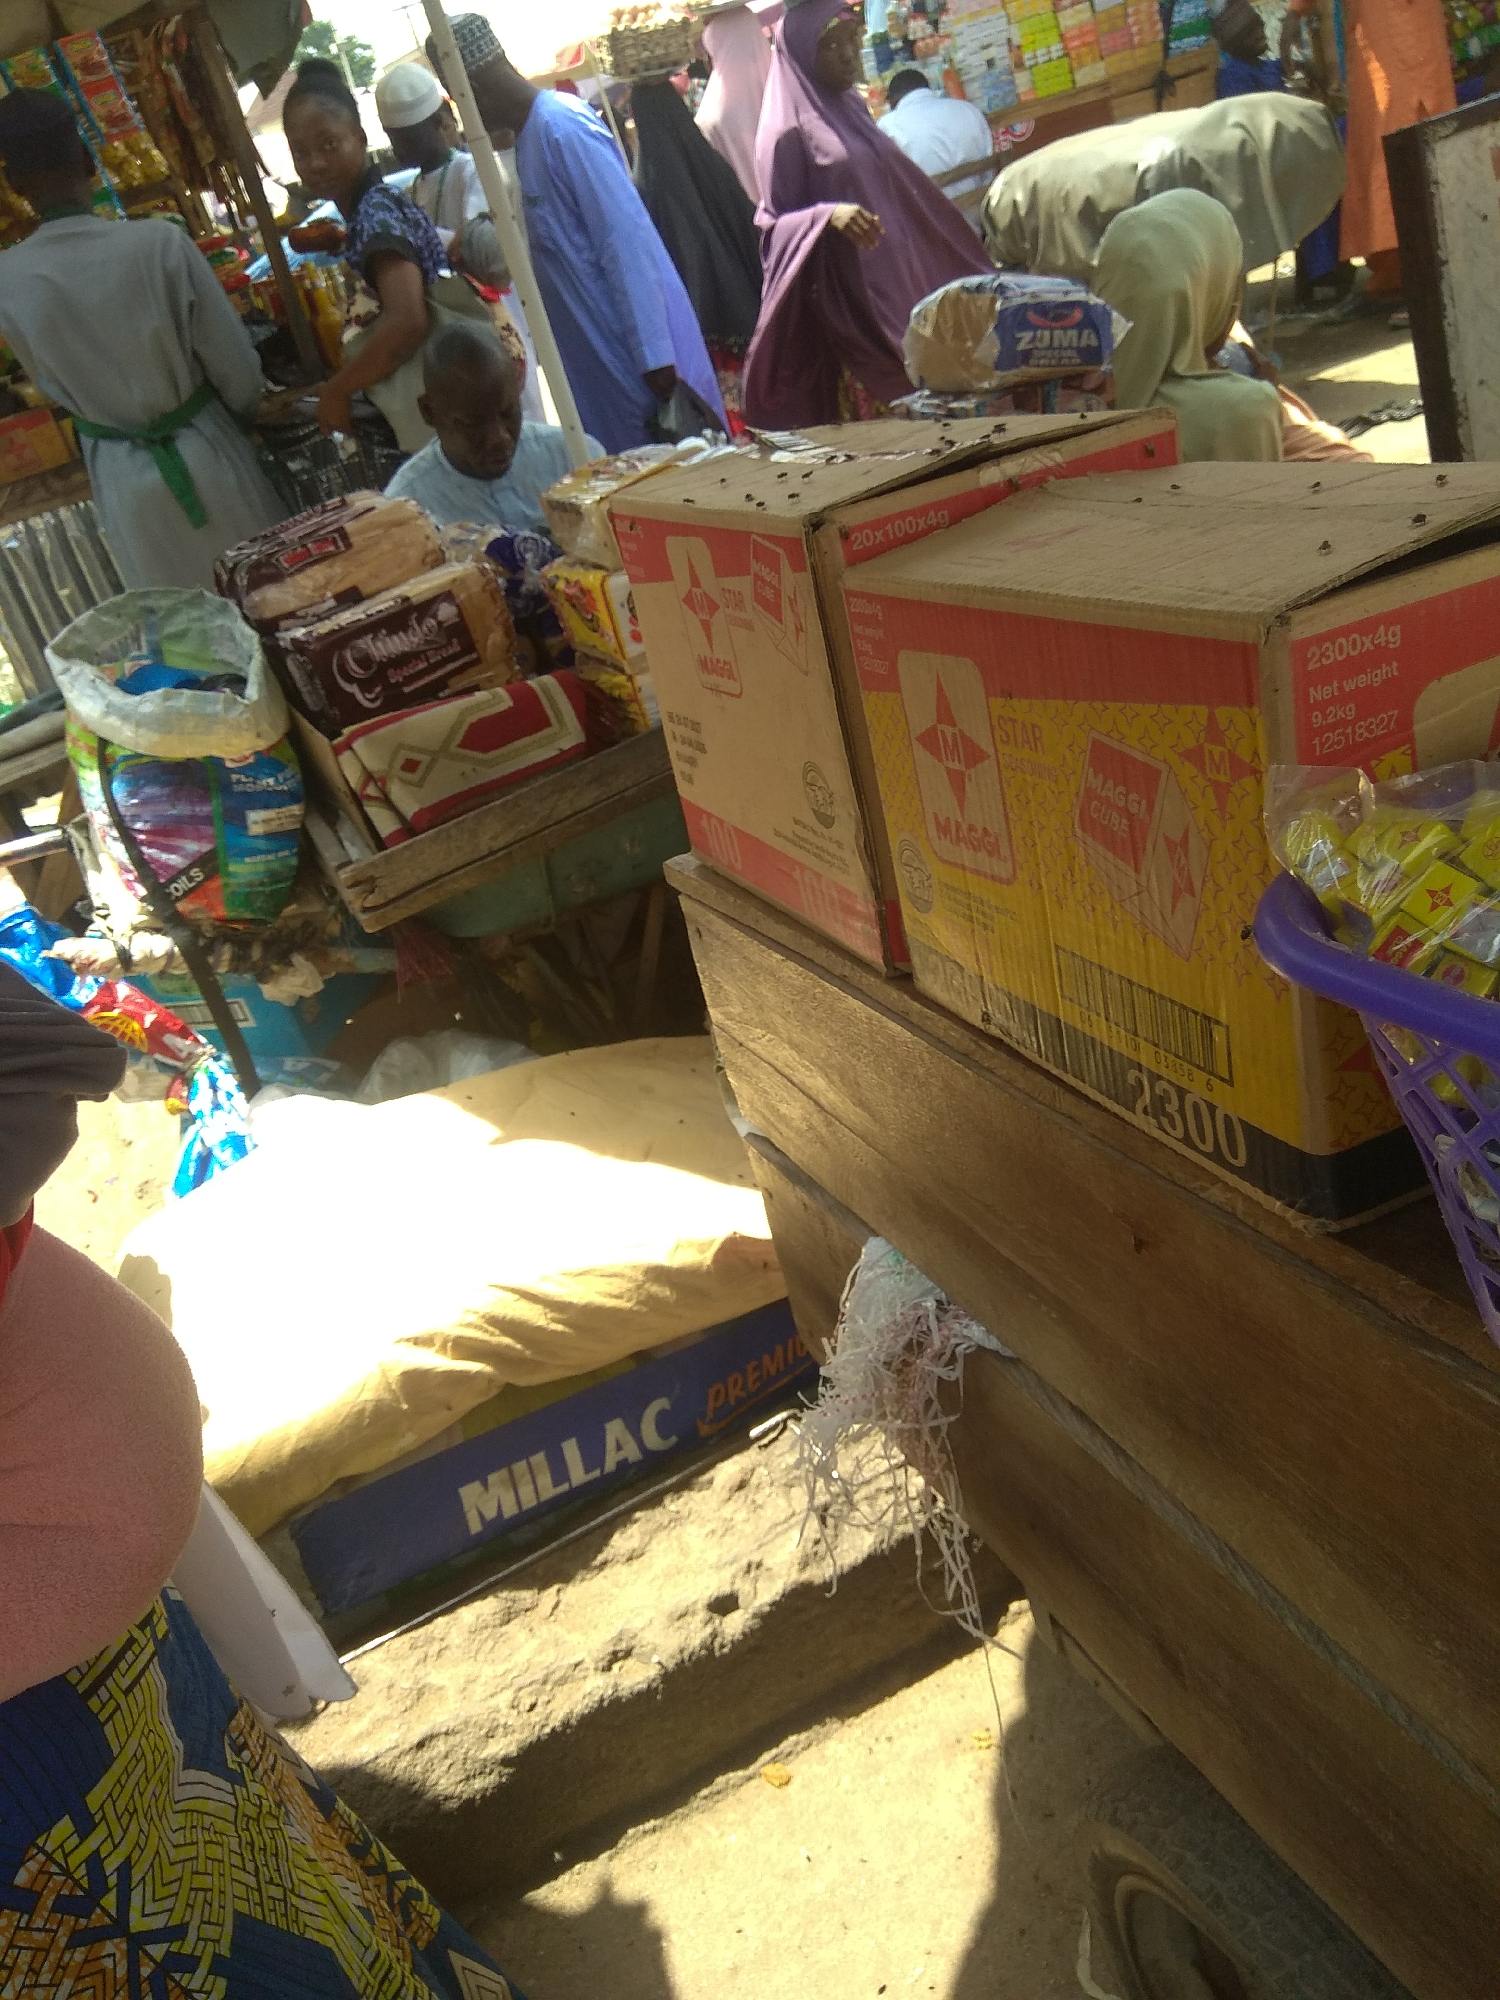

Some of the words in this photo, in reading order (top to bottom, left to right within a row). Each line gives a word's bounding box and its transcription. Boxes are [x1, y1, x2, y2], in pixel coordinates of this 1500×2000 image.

[1014, 328, 1099, 350] ZUMA
[852, 509, 949, 551] 20x100x4g
[721, 587, 748, 613] STAR
[698, 653, 738, 682] MAGGI
[1307, 624, 1401, 671] 2300x4g
[1309, 680, 1339, 703] Net
[1343, 661, 1399, 692] weight
[997, 715, 1046, 755] STAR
[1312, 703, 1356, 728] 9.2kg
[1312, 710, 1399, 756] 12518327
[1002, 753, 1059, 784] SEASONING
[1086, 768, 1150, 822] MAGGI
[932, 811, 1007, 861] MAGGI
[1089, 801, 1131, 838] CUBE
[701, 813, 742, 871] 100
[165, 867, 205, 900] OILS
[1154, 1050, 1195, 1082] 03858
[1206, 1078, 1214, 1092] 6
[1127, 1069, 1247, 1168] 2300
[458, 1397, 678, 1536] MILLAC
